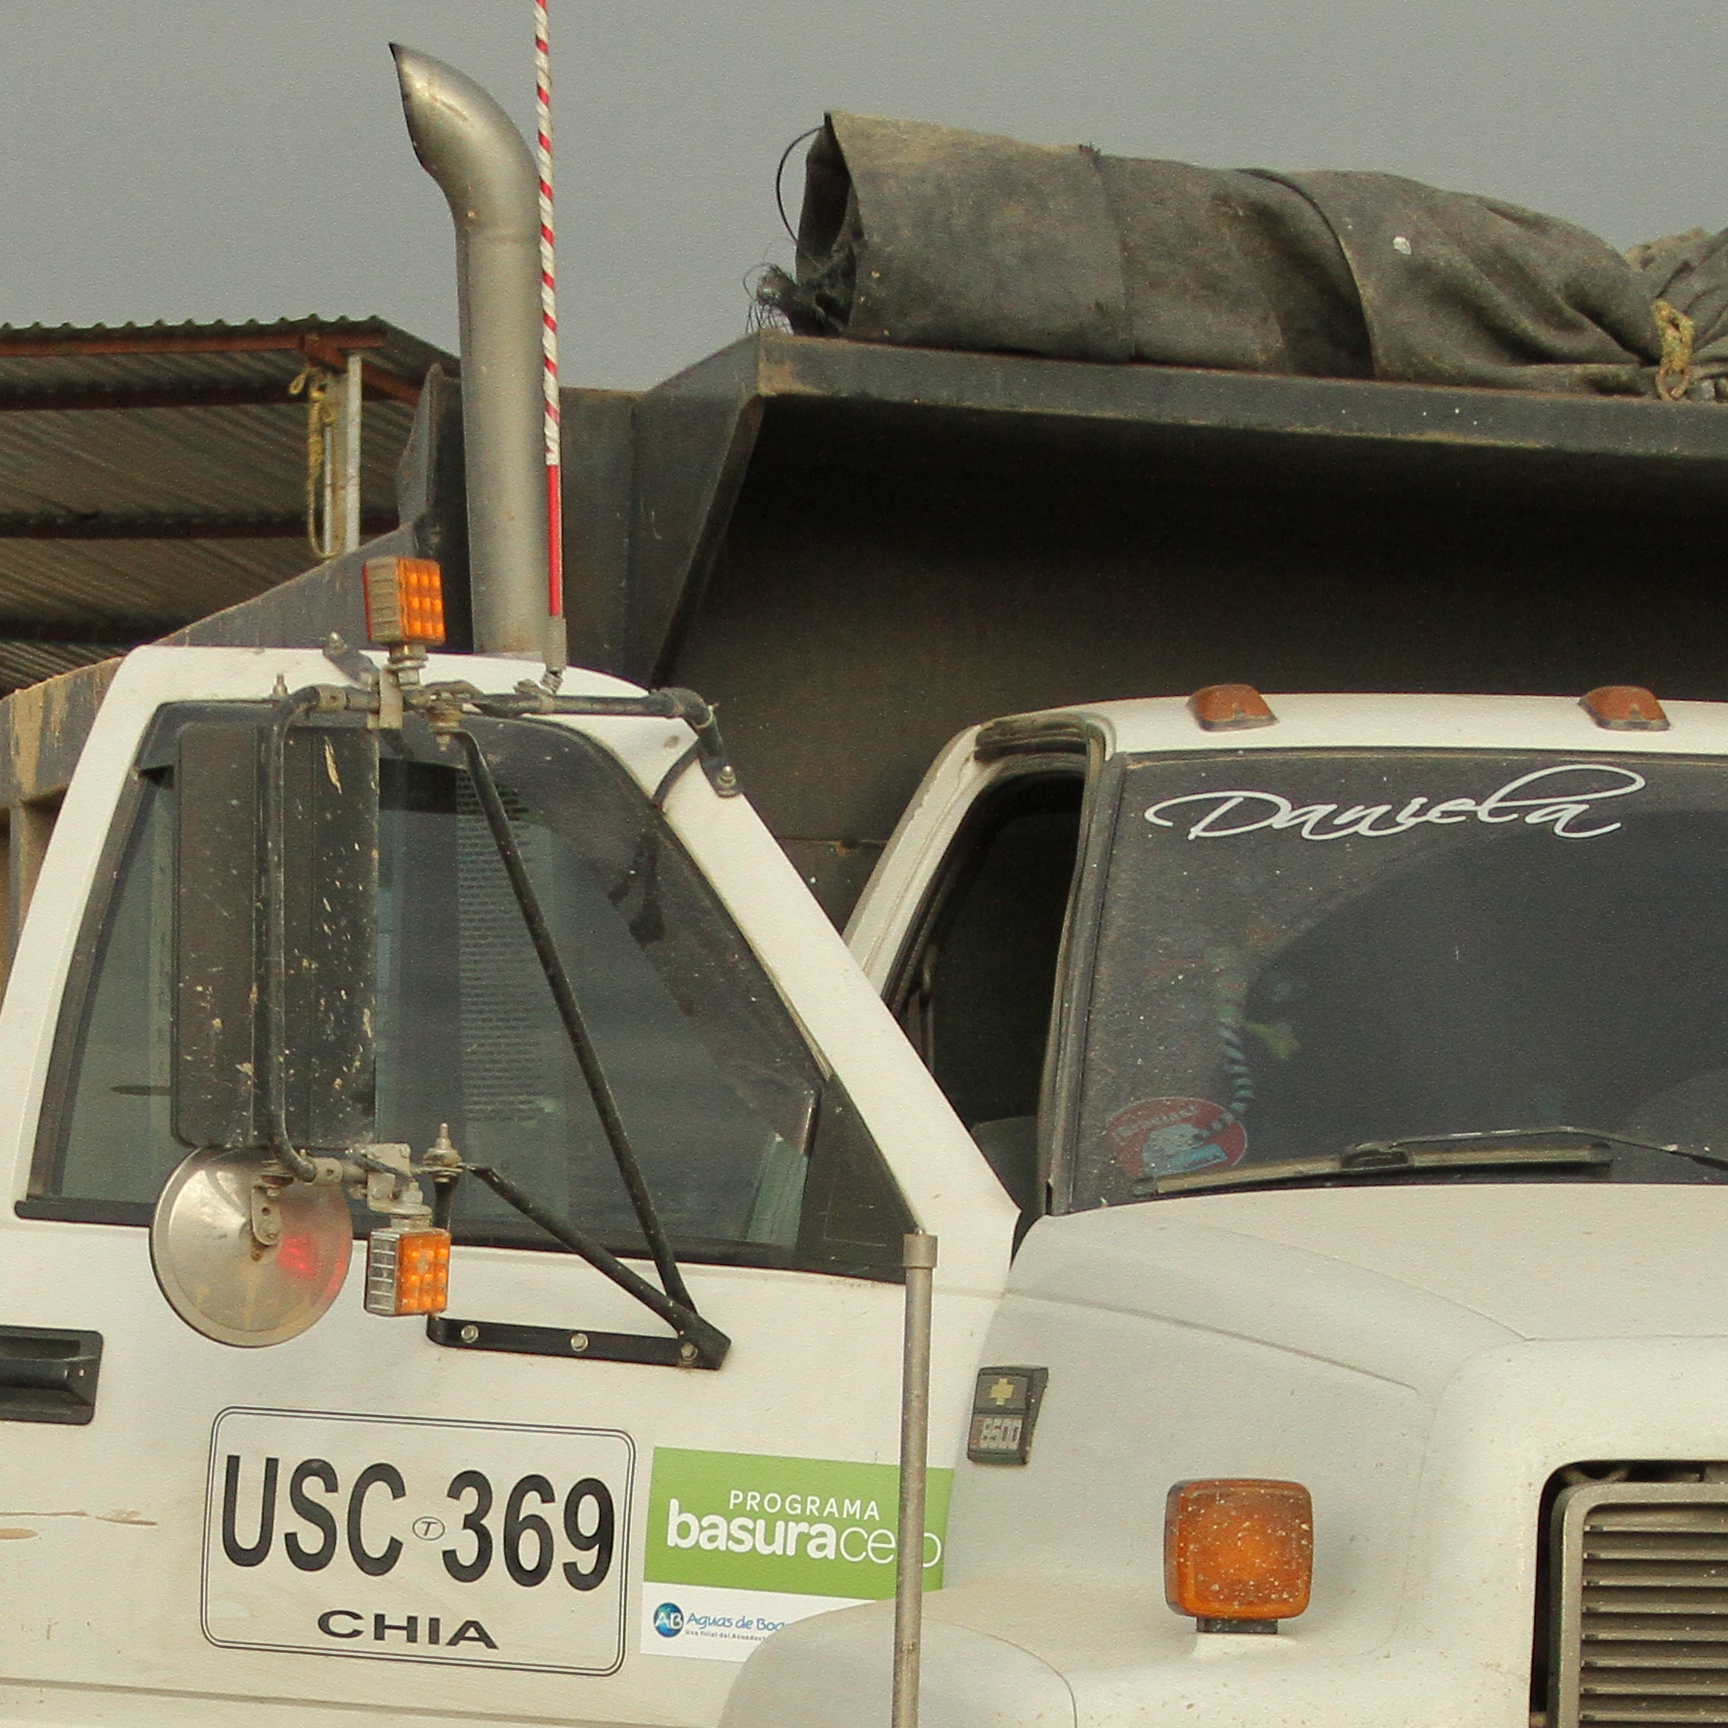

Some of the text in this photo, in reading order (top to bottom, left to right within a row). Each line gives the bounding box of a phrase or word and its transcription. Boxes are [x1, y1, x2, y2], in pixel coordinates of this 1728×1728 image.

[222, 1454, 406, 1576] USC
[442, 1469, 615, 1592] 369
[729, 1489, 881, 1521] PROGRAMA
[667, 1498, 942, 1568] basuraceo
[317, 1610, 499, 1650] CHIA
[686, 1612, 733, 1629] Aguas
[735, 1615, 754, 1629] de
